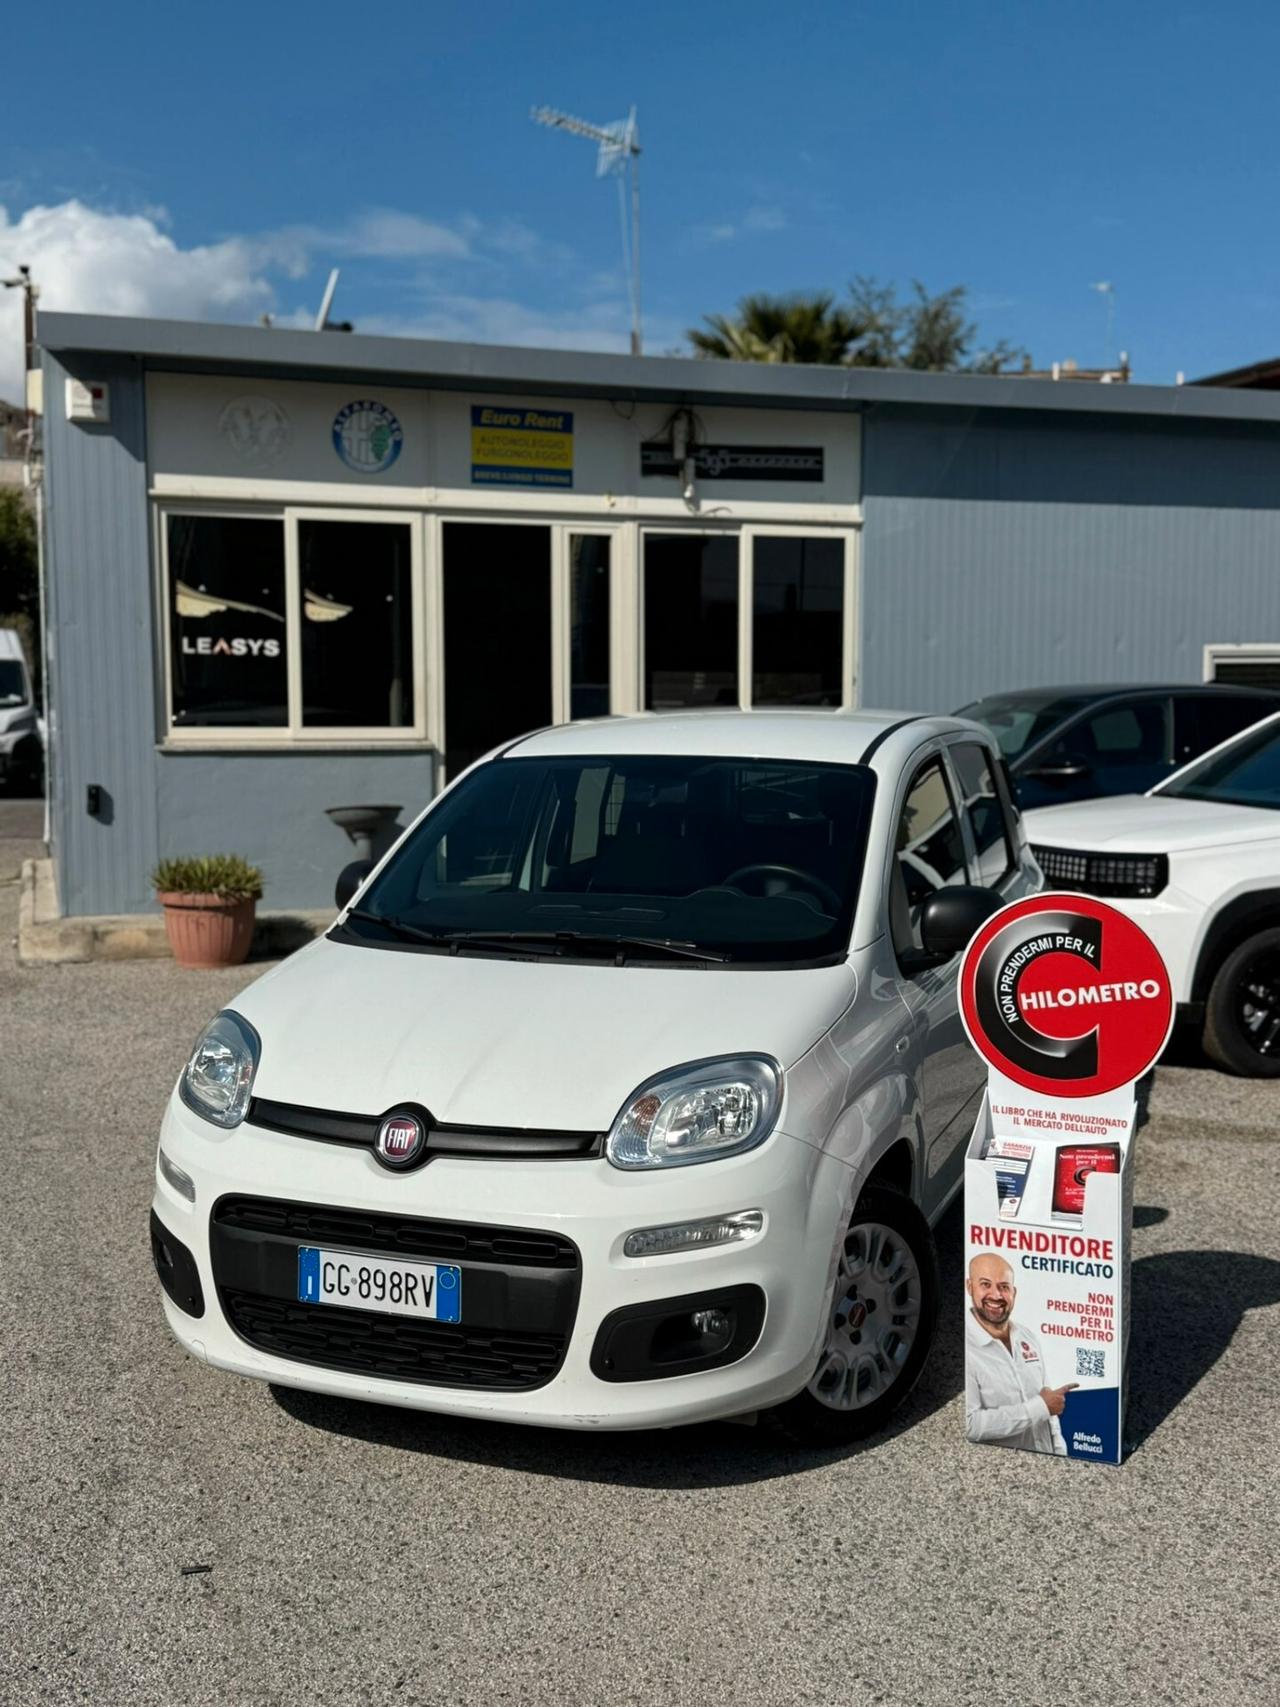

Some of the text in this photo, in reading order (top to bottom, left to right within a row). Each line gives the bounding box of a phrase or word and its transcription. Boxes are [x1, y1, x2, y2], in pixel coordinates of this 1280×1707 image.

[481, 409, 564, 428] Euro Rent
[1001, 936, 1096, 1024] NON PRENDERMI PER IL
[992, 1105, 1128, 1128] IL LIBRO CHE HA RIVOLUZIONATO
[1013, 1117, 1107, 1135] IL MERCATO DELL'AUTO
[388, 1127, 412, 1150] FIAT
[971, 1224, 1113, 1261] RIVENDITORE
[1021, 1255, 1114, 1279] CERTIFICATO
[1047, 1299, 1114, 1318] PRENDERMI
[1088, 1292, 1114, 1306] NON
[1040, 1323, 1114, 1343] CHILOMETRO
[1080, 1316, 1114, 1331] PER IL
[1073, 1432, 1101, 1444] Alfredo
[1073, 1441, 1103, 1454] Bellucci
